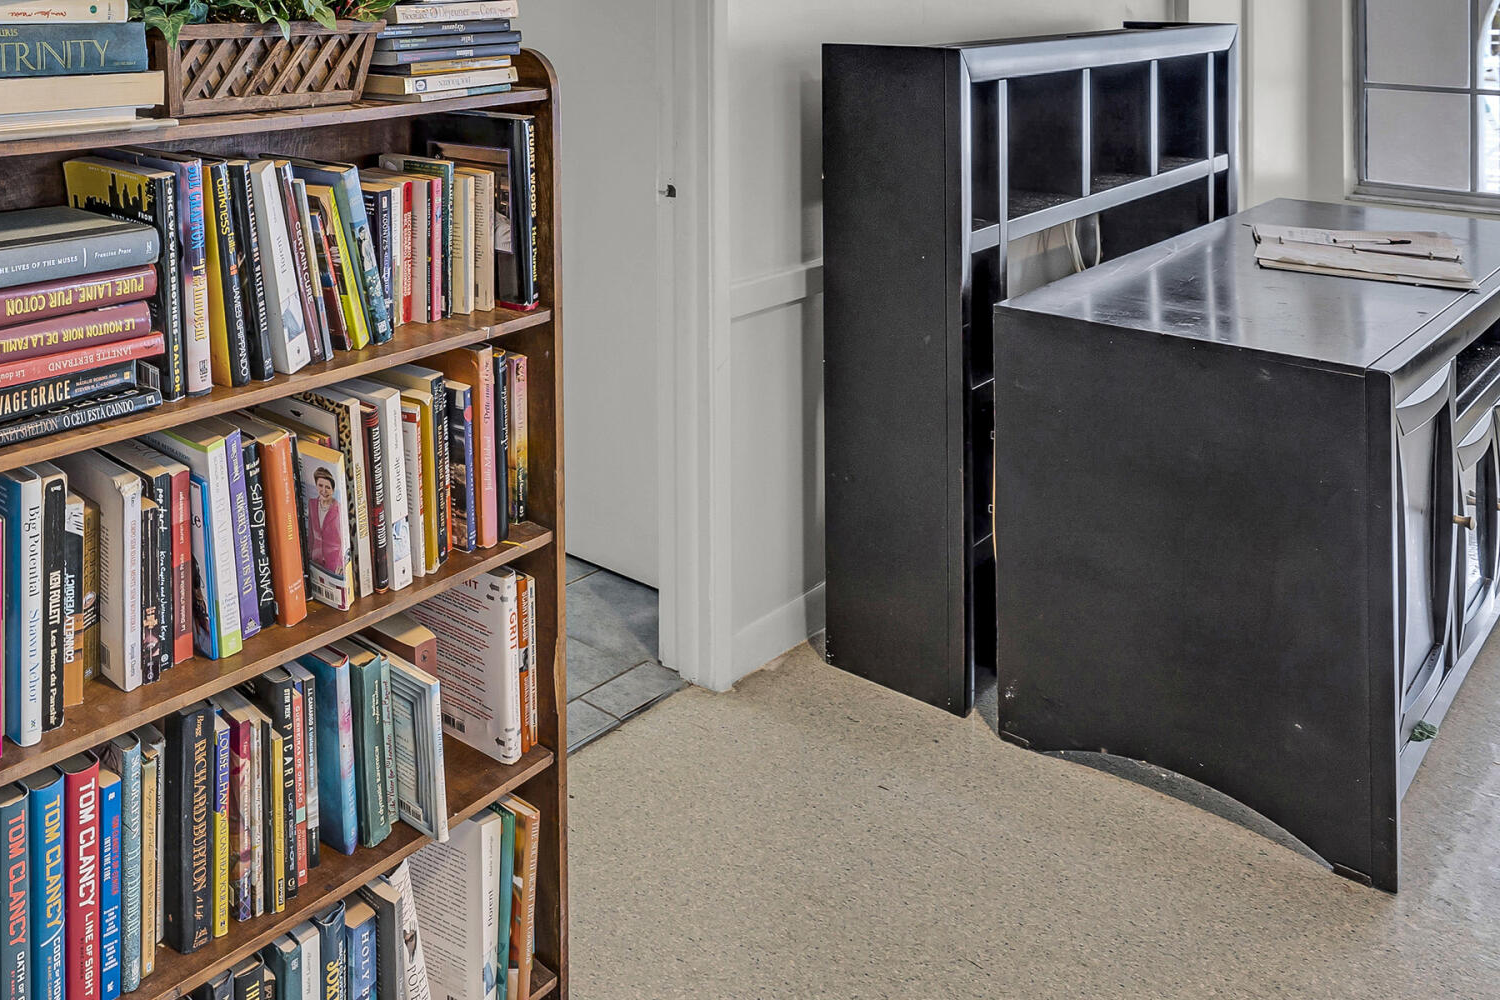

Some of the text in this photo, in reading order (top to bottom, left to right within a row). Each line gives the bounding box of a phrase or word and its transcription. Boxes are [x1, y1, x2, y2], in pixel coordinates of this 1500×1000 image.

[528, 124, 537, 170] STUART
[216, 178, 237, 255] darkness falls
[11, 263, 30, 272] LIVES
[31, 261, 41, 270] OF
[42, 259, 57, 267] THE
[57, 254, 78, 265] MUSES
[94, 250, 117, 259] Francine
[188, 166, 207, 341] SUE GRAFTON Innocent
[295, 221, 313, 305] CERTAIN CURE
[5, 277, 144, 317] PURE PUR COTON
[166, 187, 182, 393] ONCE WE WERE BROTHERS BALSON
[31, 335, 44, 348] LA
[47, 332, 59, 345] DE
[62, 327, 84, 342] NOIR
[86, 320, 123, 338] MOUTON
[124, 318, 136, 331] LE
[232, 285, 249, 377] JAMES GRIPPANDO
[48, 352, 94, 372] BERTRAND
[96, 344, 132, 361] JANETTE
[15, 369, 26, 377] Lit
[30, 380, 71, 407] GRACE
[20, 419, 59, 439] SHELDON
[63, 416, 71, 427] O
[105, 399, 135, 417] CAINDO
[372, 427, 384, 505] PATRICIA CORNWELL
[394, 457, 403, 502] Gabrielle
[438, 458, 446, 480] paix
[157, 488, 165, 504] pop
[236, 491, 248, 536] CHEMIN
[160, 507, 168, 532] tart
[239, 538, 249, 566] LONG
[250, 483, 274, 606] DANSE LOUPS
[24, 505, 41, 704] Big Potential Shawn Achor
[243, 580, 253, 595] UN
[64, 574, 75, 663] VERDICT CONNELLY
[159, 625, 167, 641] Kaye
[509, 612, 517, 651] GRIT
[48, 570, 61, 726] KEN FOLLETT Les lions du Panshir
[220, 731, 229, 770] LOUISE
[284, 722, 294, 789] PICARD
[295, 758, 302, 769] DE
[295, 771, 304, 808] ORAÇÃO
[384, 733, 396, 816] Like Water Chocolate
[131, 754, 141, 840] SUE GRAFTON
[220, 782, 229, 806] HAY
[287, 792, 295, 818] LAST
[377, 783, 385, 813] dynastie
[193, 715, 207, 920] Bragg RICHARD BURTON Life
[220, 816, 228, 835] YOU
[288, 819, 296, 844] BEST
[103, 837, 111, 882] INTO THE FIRE
[220, 836, 228, 855] CAN
[288, 845, 296, 872] HOPE
[44, 794, 63, 969] TOM CLANCY CODE
[220, 856, 228, 877] HEAL
[526, 820, 539, 923] THE SOUTH BEACH DIET
[8, 809, 26, 993] TOM CLANCY OATH OF
[79, 777, 95, 996] TOM CLANCY LINE OF SIGHT
[220, 880, 228, 903] YOUR
[361, 930, 371, 980] HOLY
